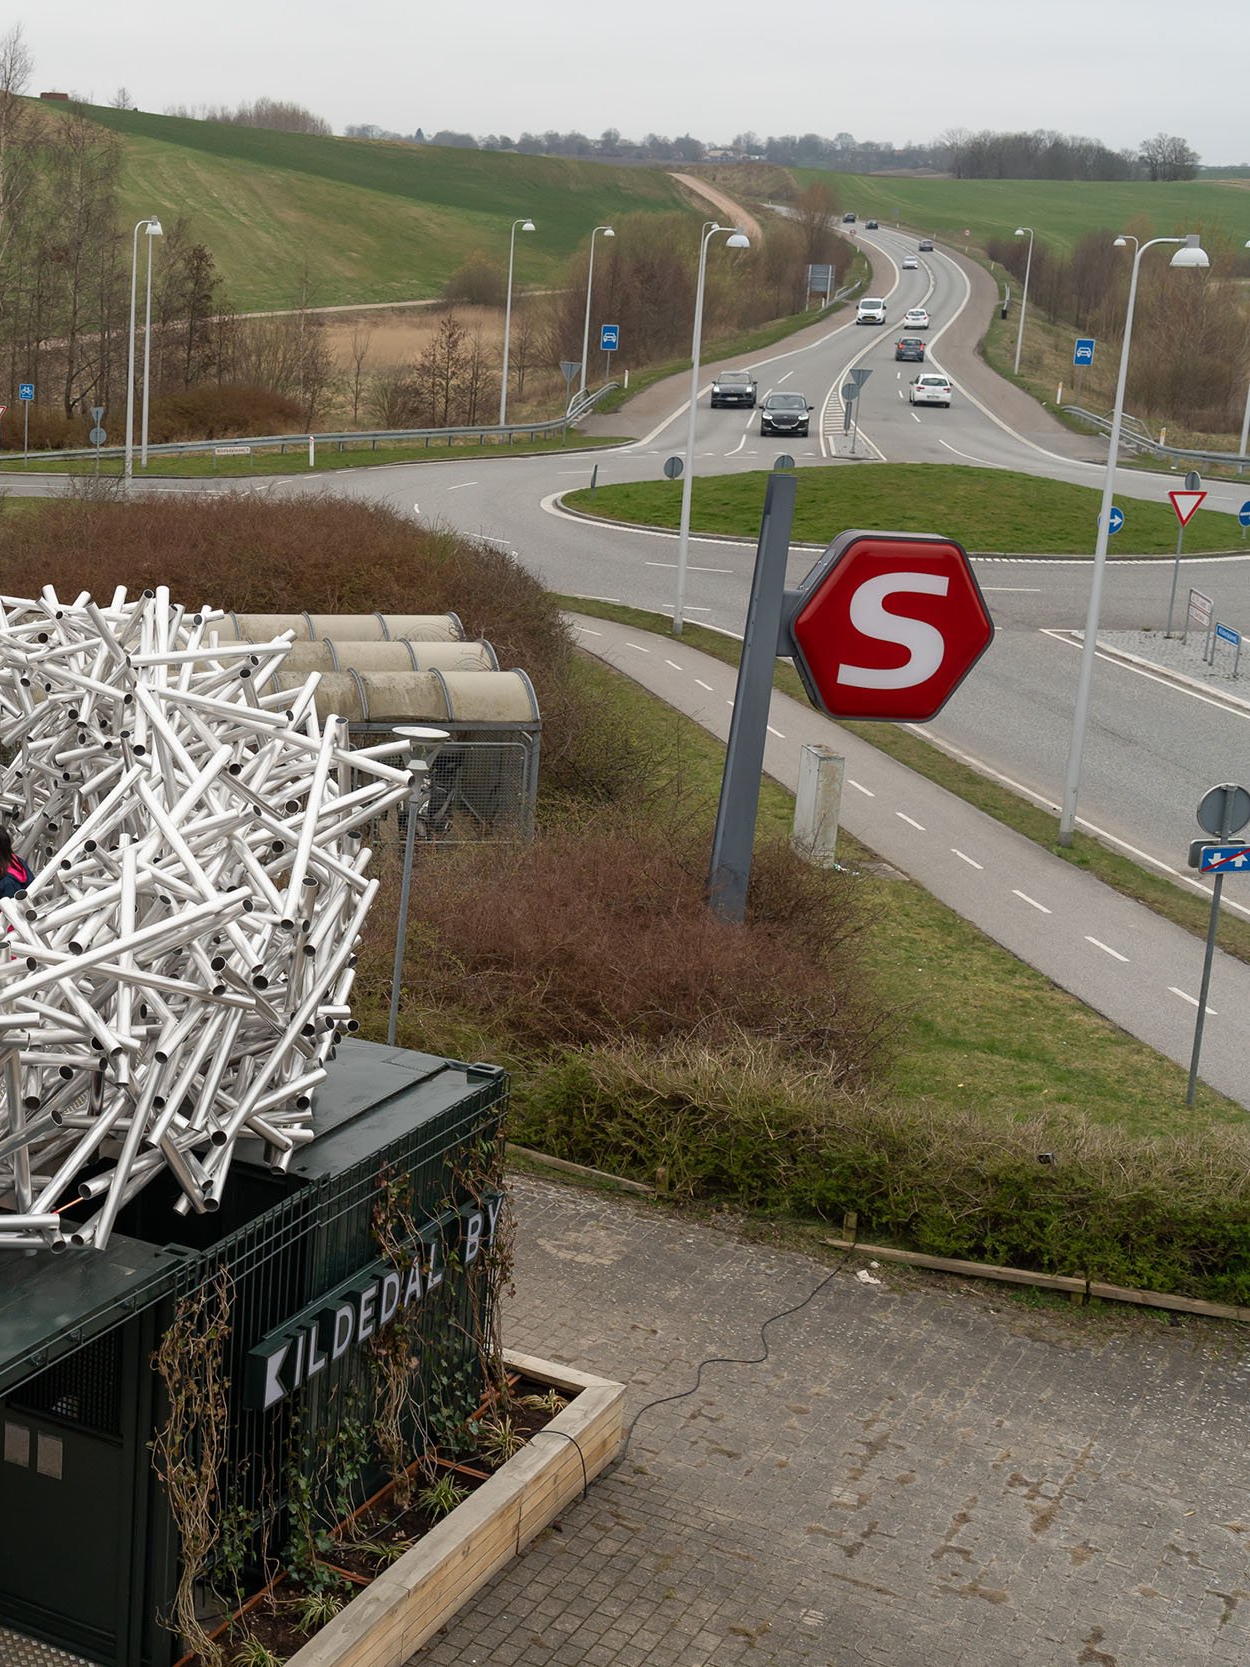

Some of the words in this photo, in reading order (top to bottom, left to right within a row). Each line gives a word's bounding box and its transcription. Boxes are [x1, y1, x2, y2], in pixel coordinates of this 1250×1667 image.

[837, 572, 950, 690] S
[264, 1242, 444, 1409] KILDEDAL
[465, 1196, 504, 1264] BY
